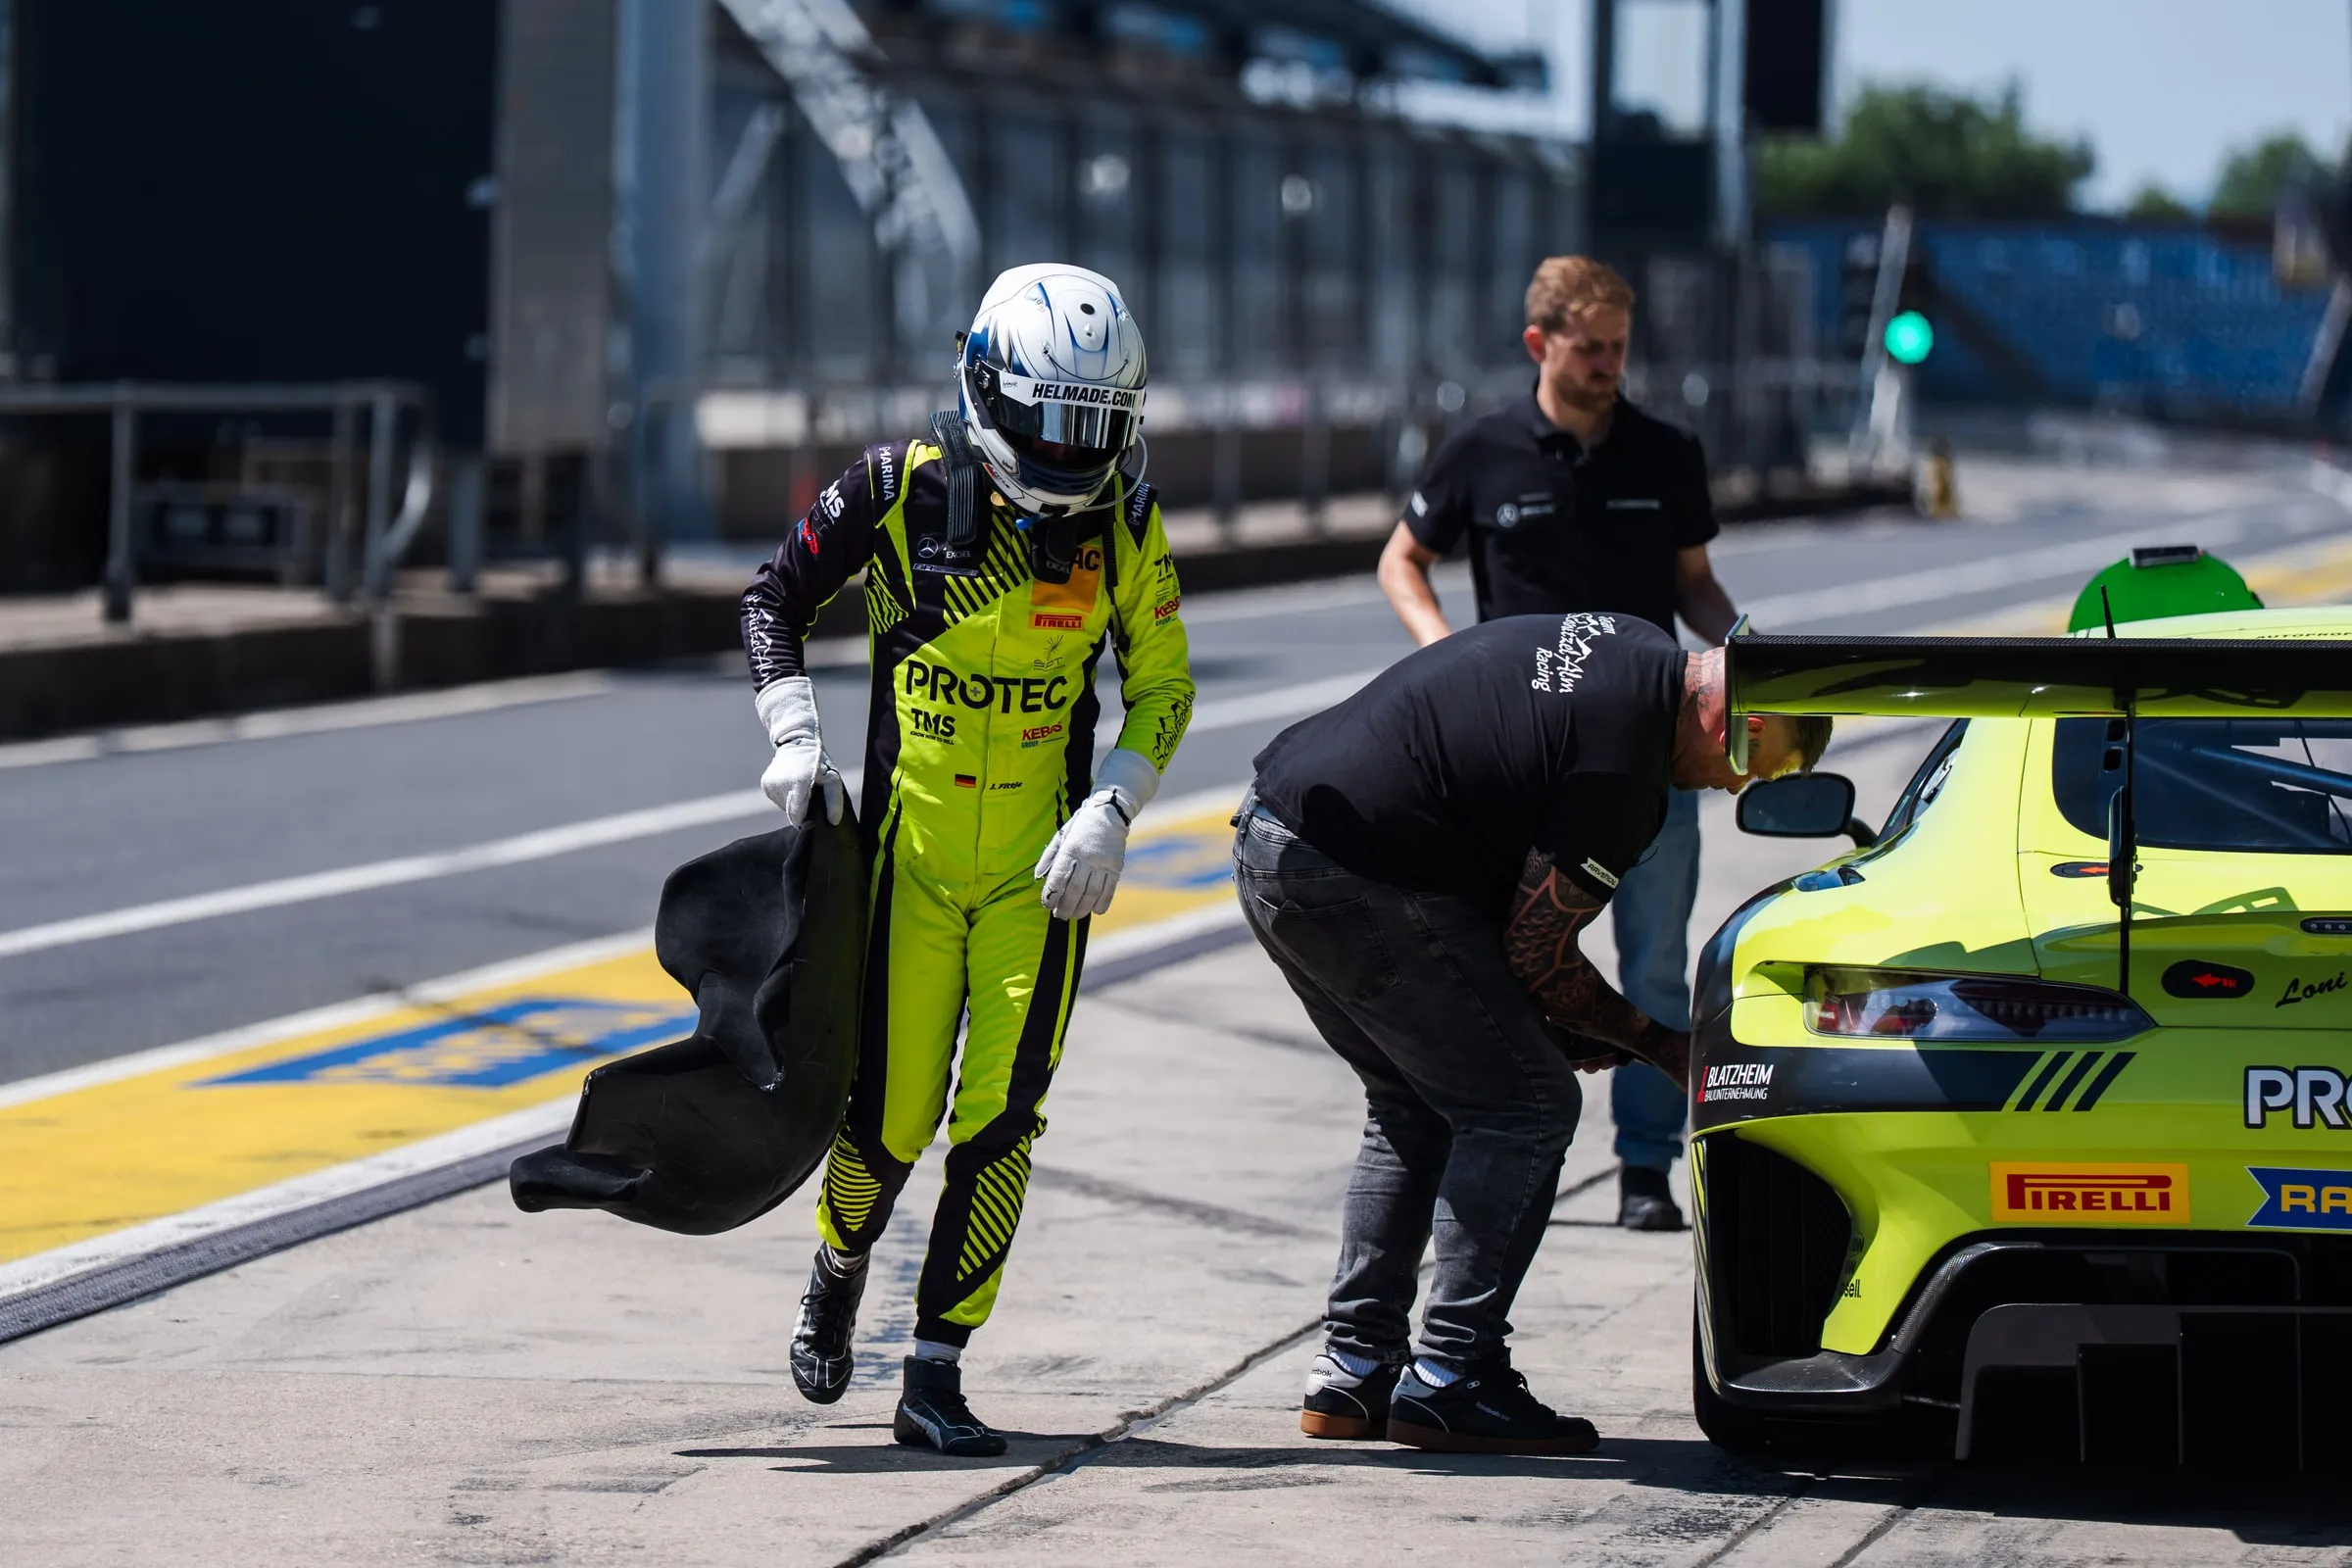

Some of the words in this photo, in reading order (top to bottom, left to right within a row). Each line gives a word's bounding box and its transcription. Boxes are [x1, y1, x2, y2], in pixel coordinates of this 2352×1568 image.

[1032, 383, 1137, 408] HELMADE.COM
[878, 446, 895, 501] MARINA
[824, 478, 845, 517] MS
[1070, 548, 1101, 570] AC
[1153, 550, 1173, 577] TM
[1035, 613, 1082, 628] PIRELLI
[906, 659, 1068, 713] PROTEC
[1531, 647, 1554, 693] Racing
[910, 708, 956, 737] TMS
[1706, 1063, 1775, 1088] BLATZHEIM
[2244, 1065, 2352, 1129] PR
[2006, 1174, 2173, 1211] PIRELLI
